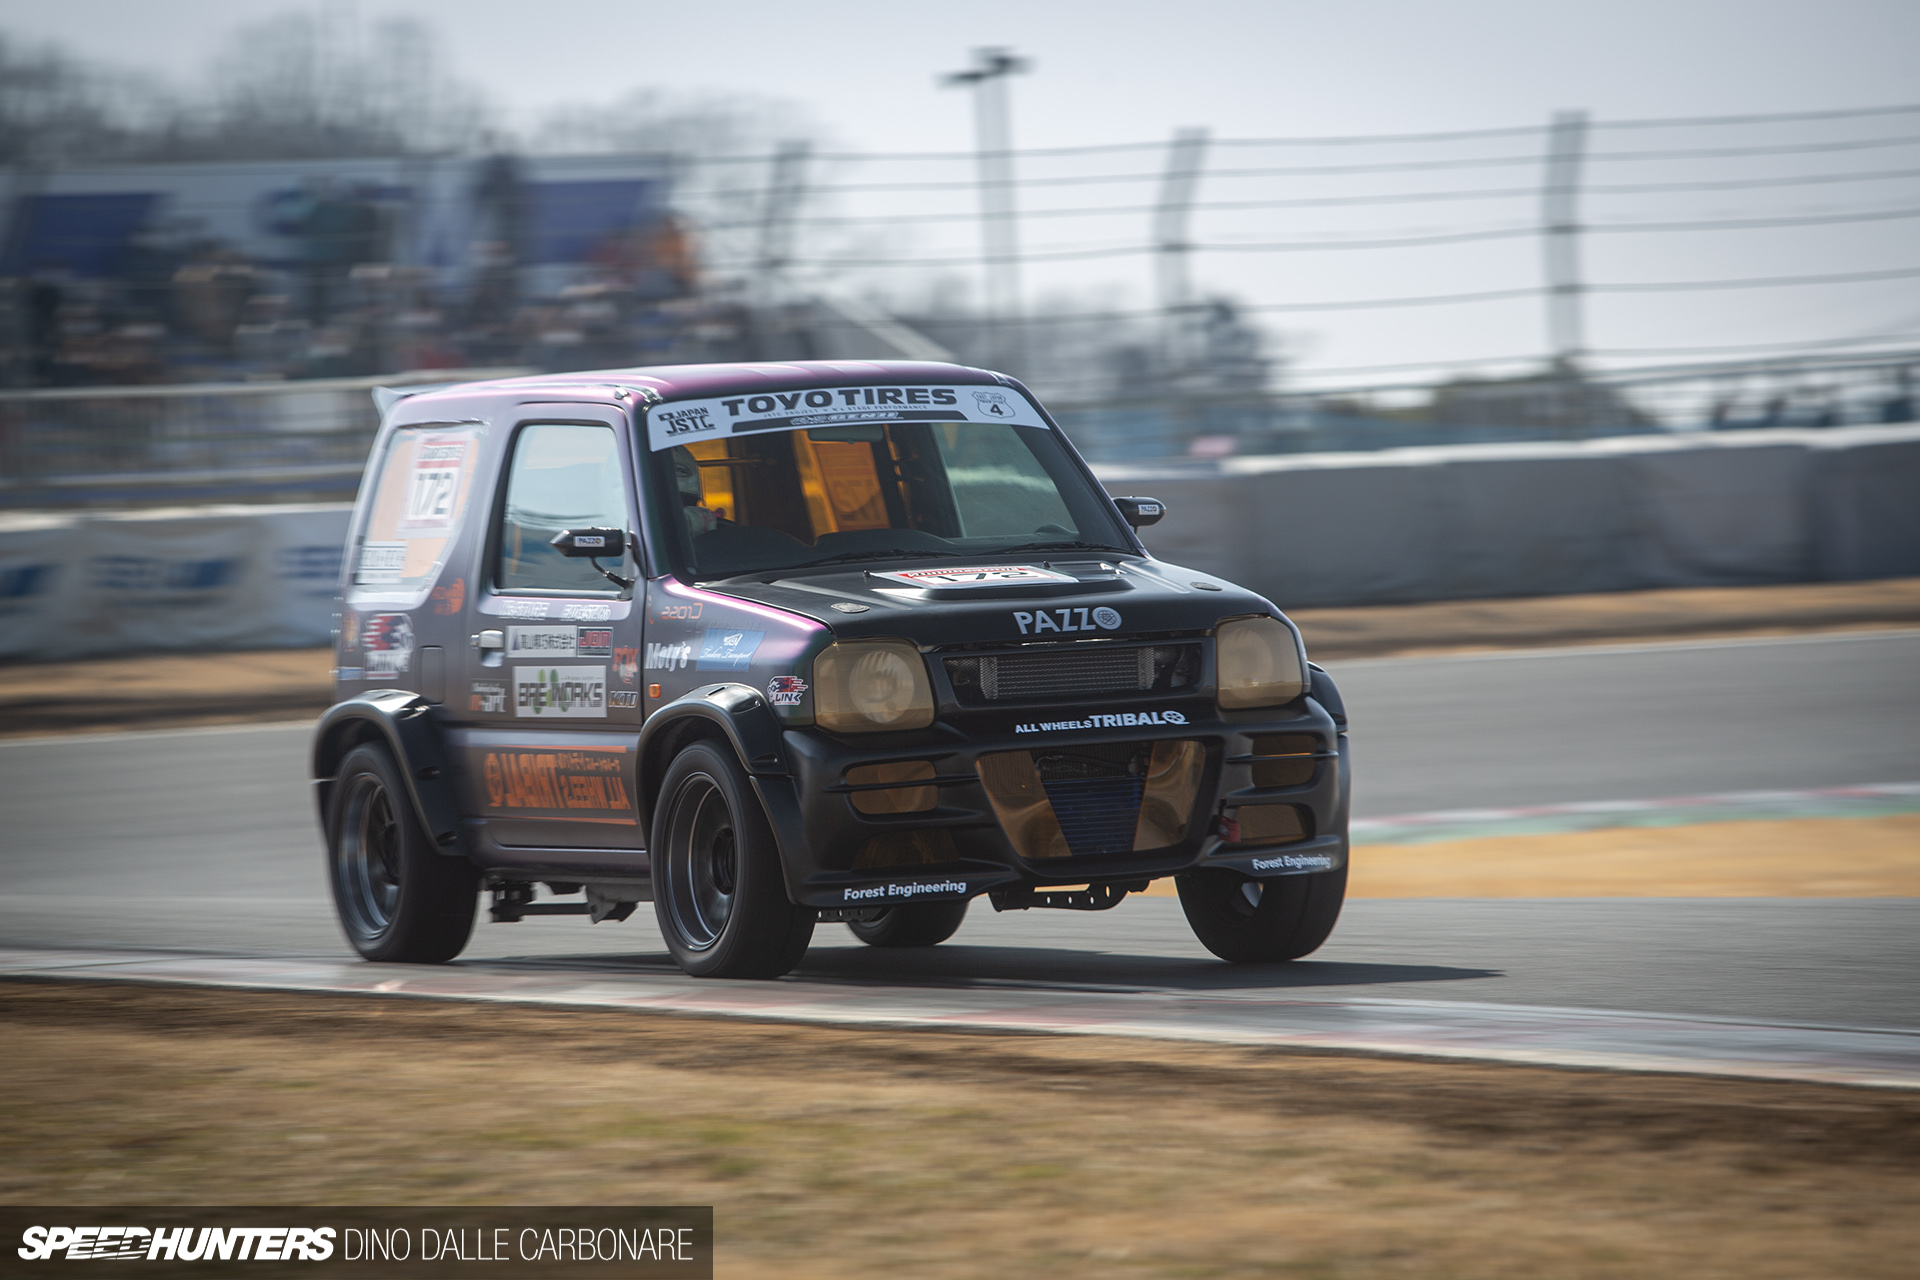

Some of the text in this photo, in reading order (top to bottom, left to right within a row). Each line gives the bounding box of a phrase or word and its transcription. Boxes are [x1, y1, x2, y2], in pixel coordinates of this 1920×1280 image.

[675, 406, 709, 419] JAPAN
[722, 388, 958, 417] TOYO TIRES
[990, 404, 1004, 416] 4
[665, 415, 716, 435] JSTC
[411, 472, 453, 516] 172
[927, 571, 1039, 584] 172
[1013, 606, 1123, 635] PAZZO
[645, 641, 692, 672] Moty's
[1015, 724, 1040, 733] ALL
[1088, 711, 1167, 728] TRIBAL
[1252, 854, 1332, 871] Forest Engineering
[844, 880, 967, 900] Forest Engineering
